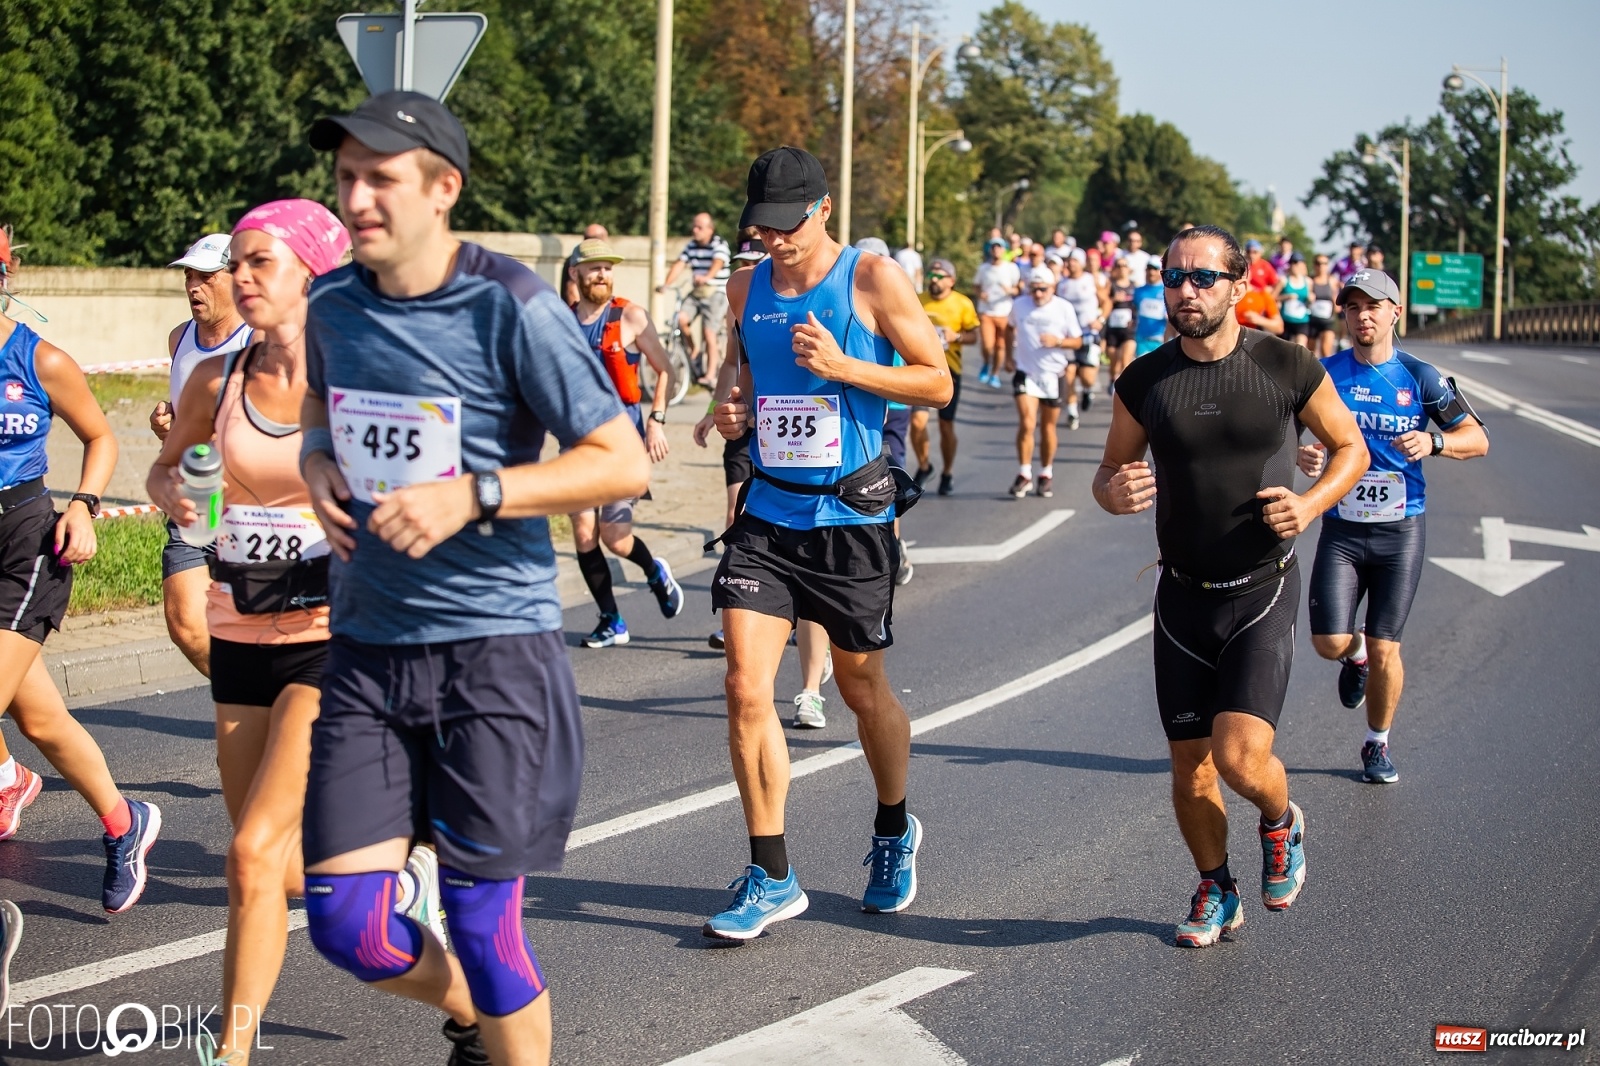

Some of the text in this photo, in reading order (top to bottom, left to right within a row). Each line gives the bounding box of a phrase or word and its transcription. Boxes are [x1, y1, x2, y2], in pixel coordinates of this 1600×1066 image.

[777, 415, 817, 438] 355
[363, 424, 421, 461] 455
[1356, 485, 1389, 502] 245
[247, 533, 302, 561] 228
[727, 577, 760, 587] Sumitomo
